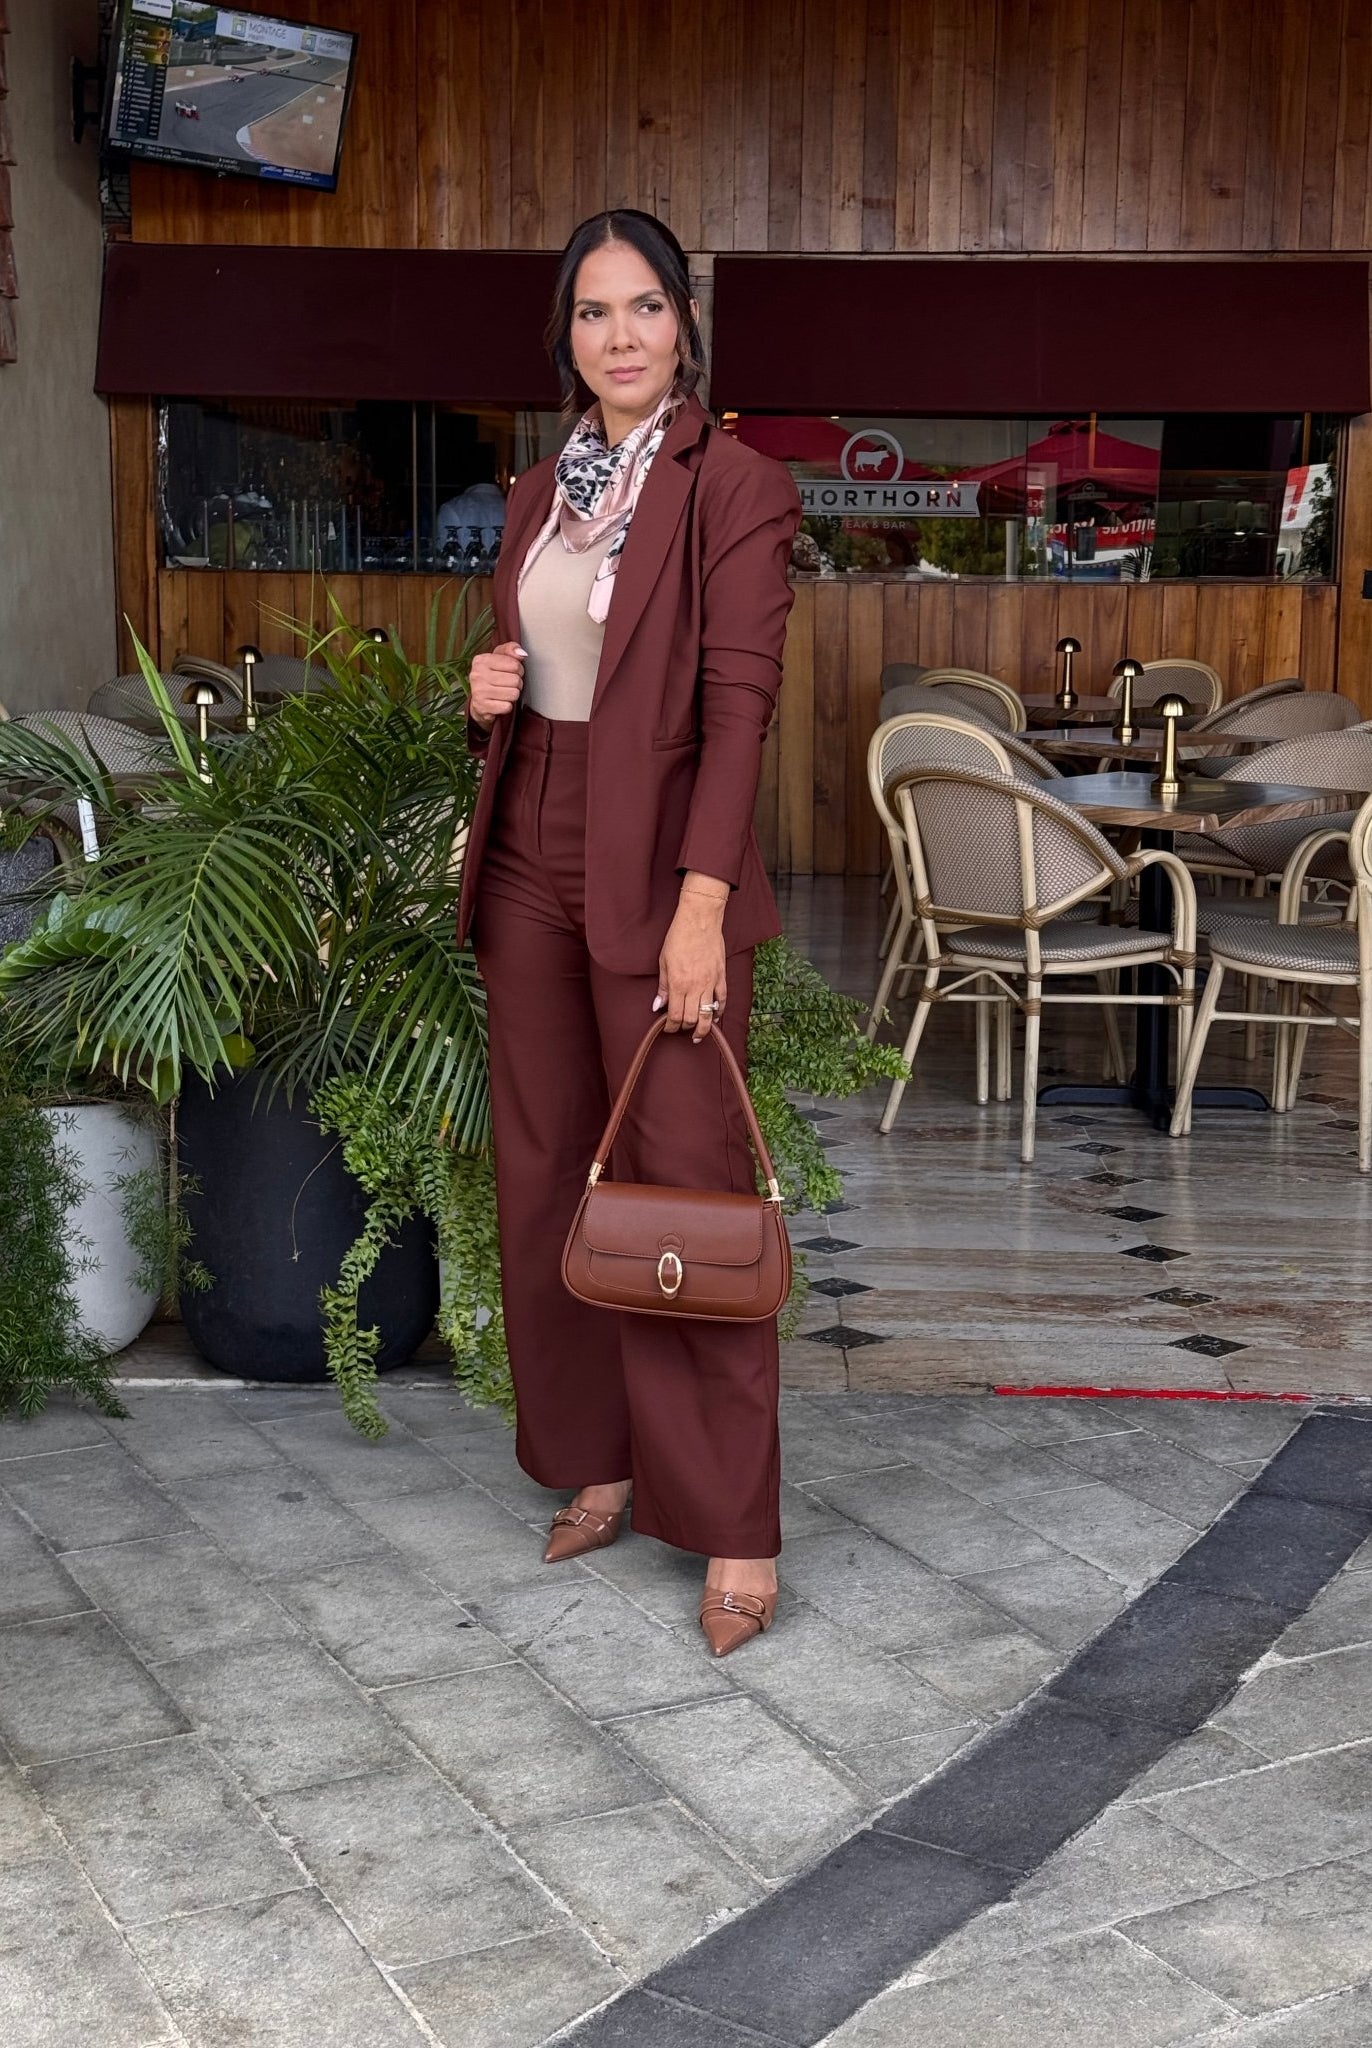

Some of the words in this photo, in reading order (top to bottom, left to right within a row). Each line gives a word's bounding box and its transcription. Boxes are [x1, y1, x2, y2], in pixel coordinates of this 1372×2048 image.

[800, 488, 962, 507] HORTHORN
[832, 519, 869, 529] STEAK
[883, 520, 906, 529] BAR
